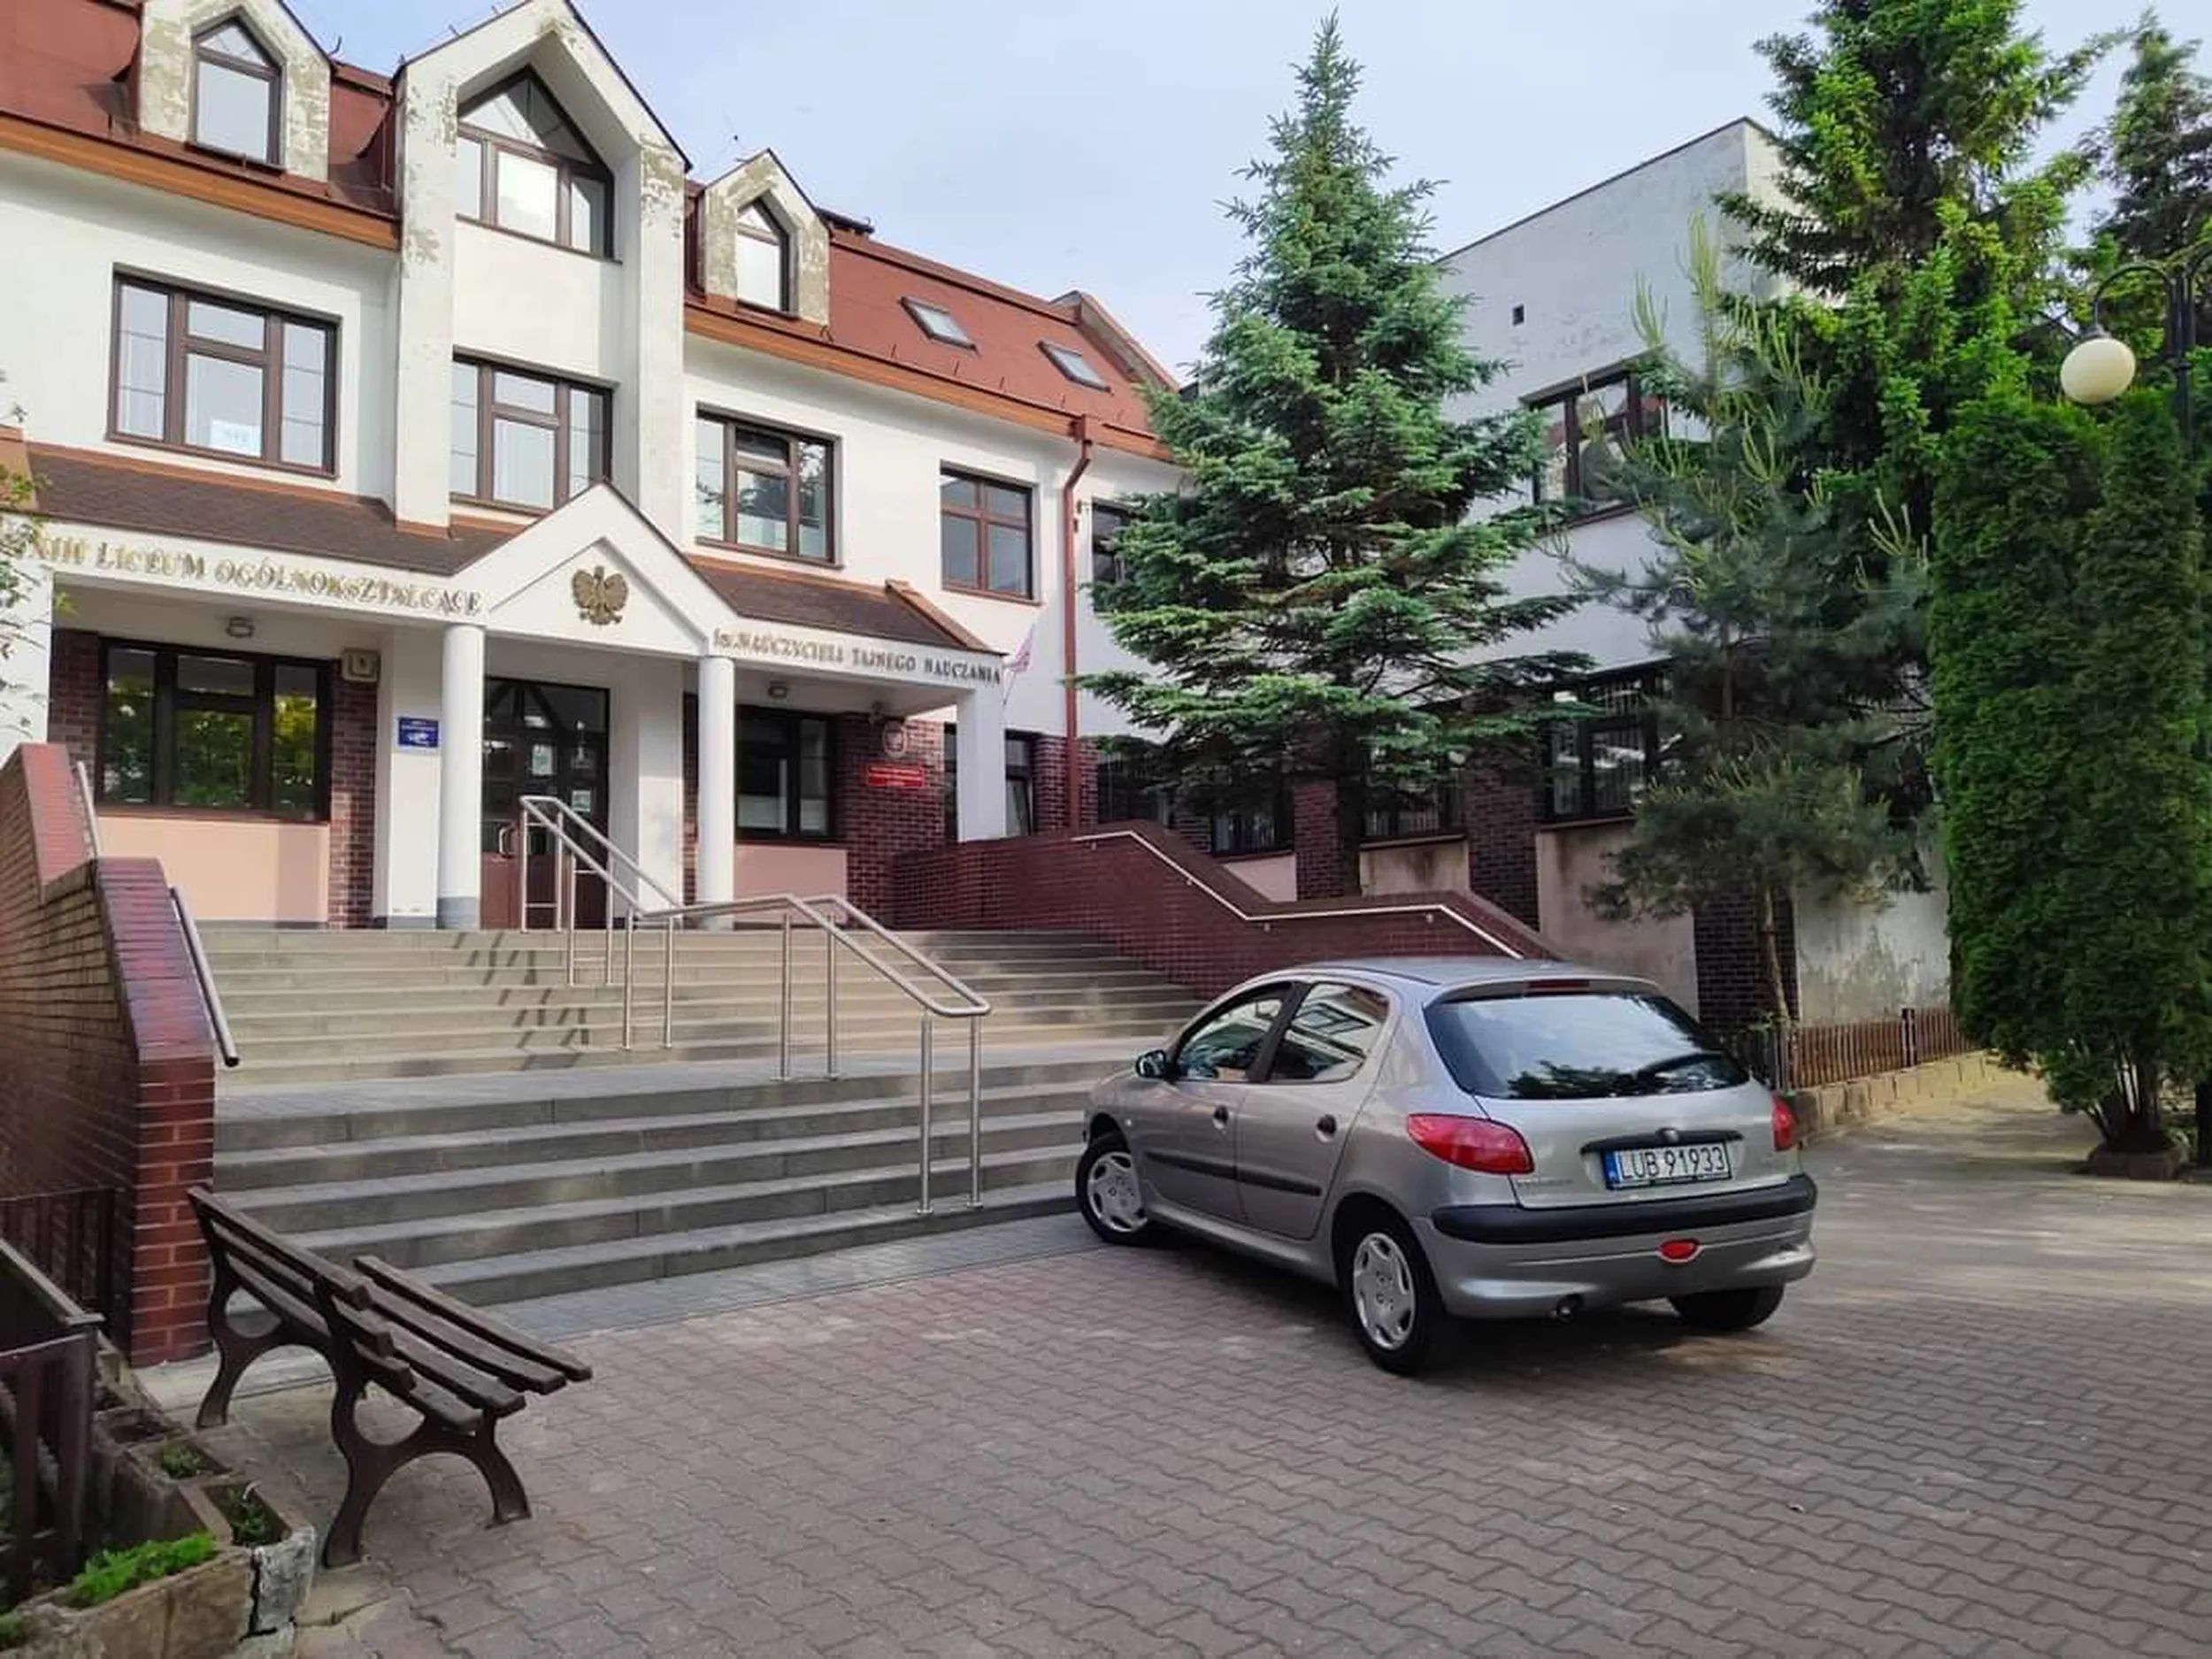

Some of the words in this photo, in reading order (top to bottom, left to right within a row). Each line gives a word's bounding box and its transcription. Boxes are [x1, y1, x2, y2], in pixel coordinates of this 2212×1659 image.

[96, 541, 206, 580] LICEUM
[852, 647, 917, 672] TAJNEGO
[924, 657, 1001, 685] NAUCZANIA
[1619, 1150, 1659, 1179] LUB
[1664, 1147, 1725, 1176] 91933
